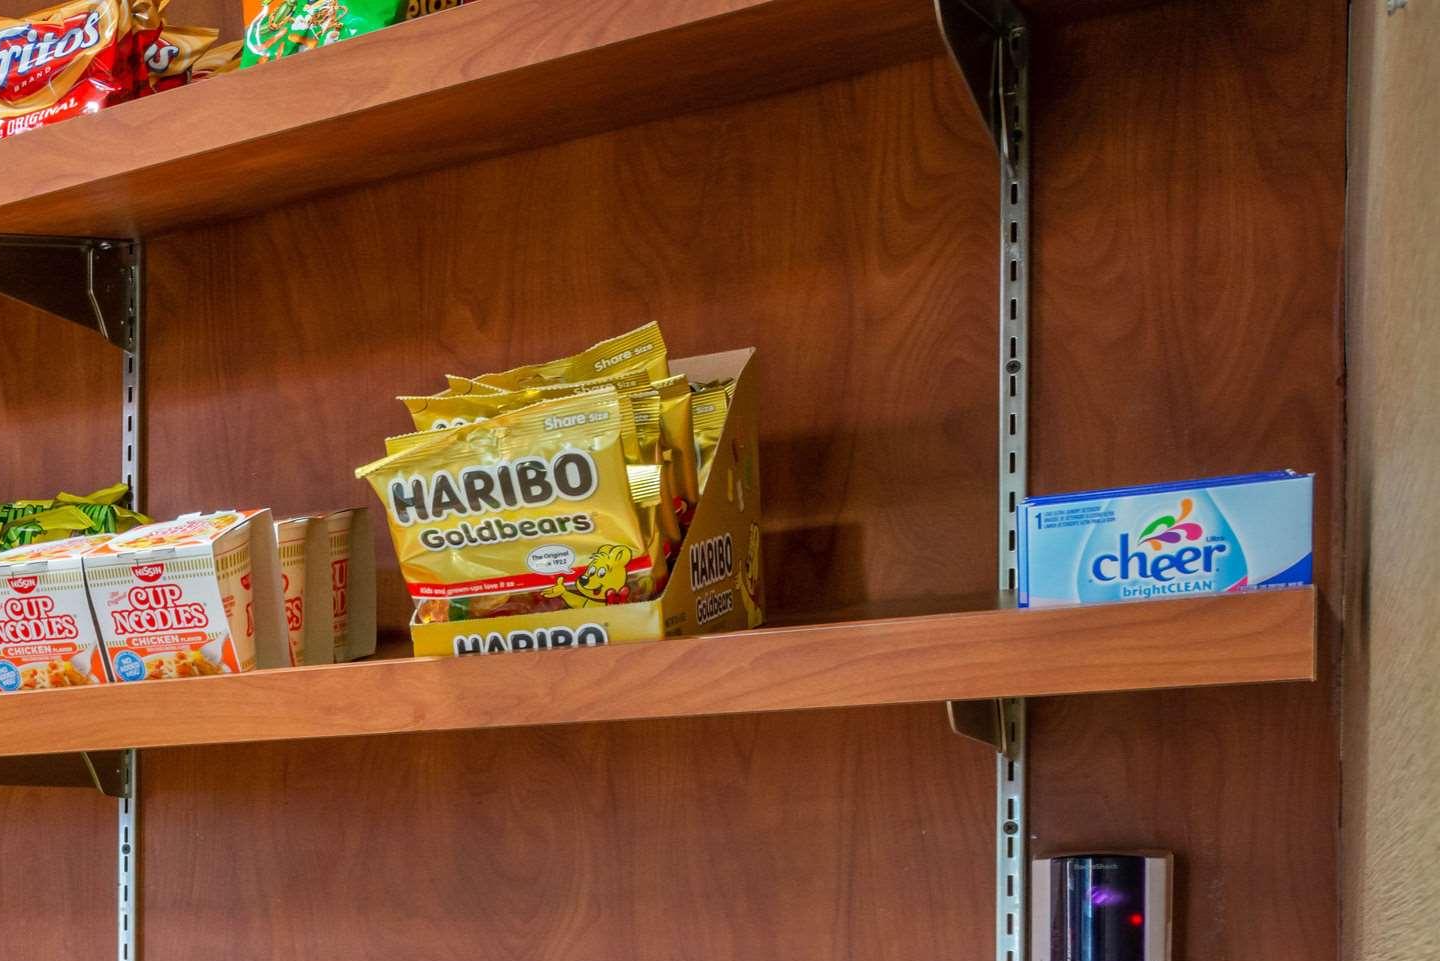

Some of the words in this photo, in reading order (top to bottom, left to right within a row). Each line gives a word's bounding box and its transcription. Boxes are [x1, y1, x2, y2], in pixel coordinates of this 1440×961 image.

[13, 66, 53, 92] BRAND
[6, 97, 79, 134] ORIGINAL
[594, 350, 632, 373] Share
[544, 413, 586, 431] Share
[391, 452, 594, 523] HARIBO
[421, 514, 592, 549] Goldbears
[542, 550, 570, 561] Original
[690, 533, 733, 591] HARIBO
[1092, 533, 1227, 582] cheer
[11, 579, 37, 590] NISSIN
[134, 566, 162, 578] NISSIN
[128, 583, 182, 610] CUP
[483, 582, 499, 591] love
[1122, 581, 1212, 600] brightCLEAN
[4, 596, 54, 621] CUP
[111, 602, 210, 636] NOODLES
[696, 590, 733, 624] Goldbears
[7, 645, 53, 657] CHICKEN
[131, 635, 180, 647] CHICKEN
